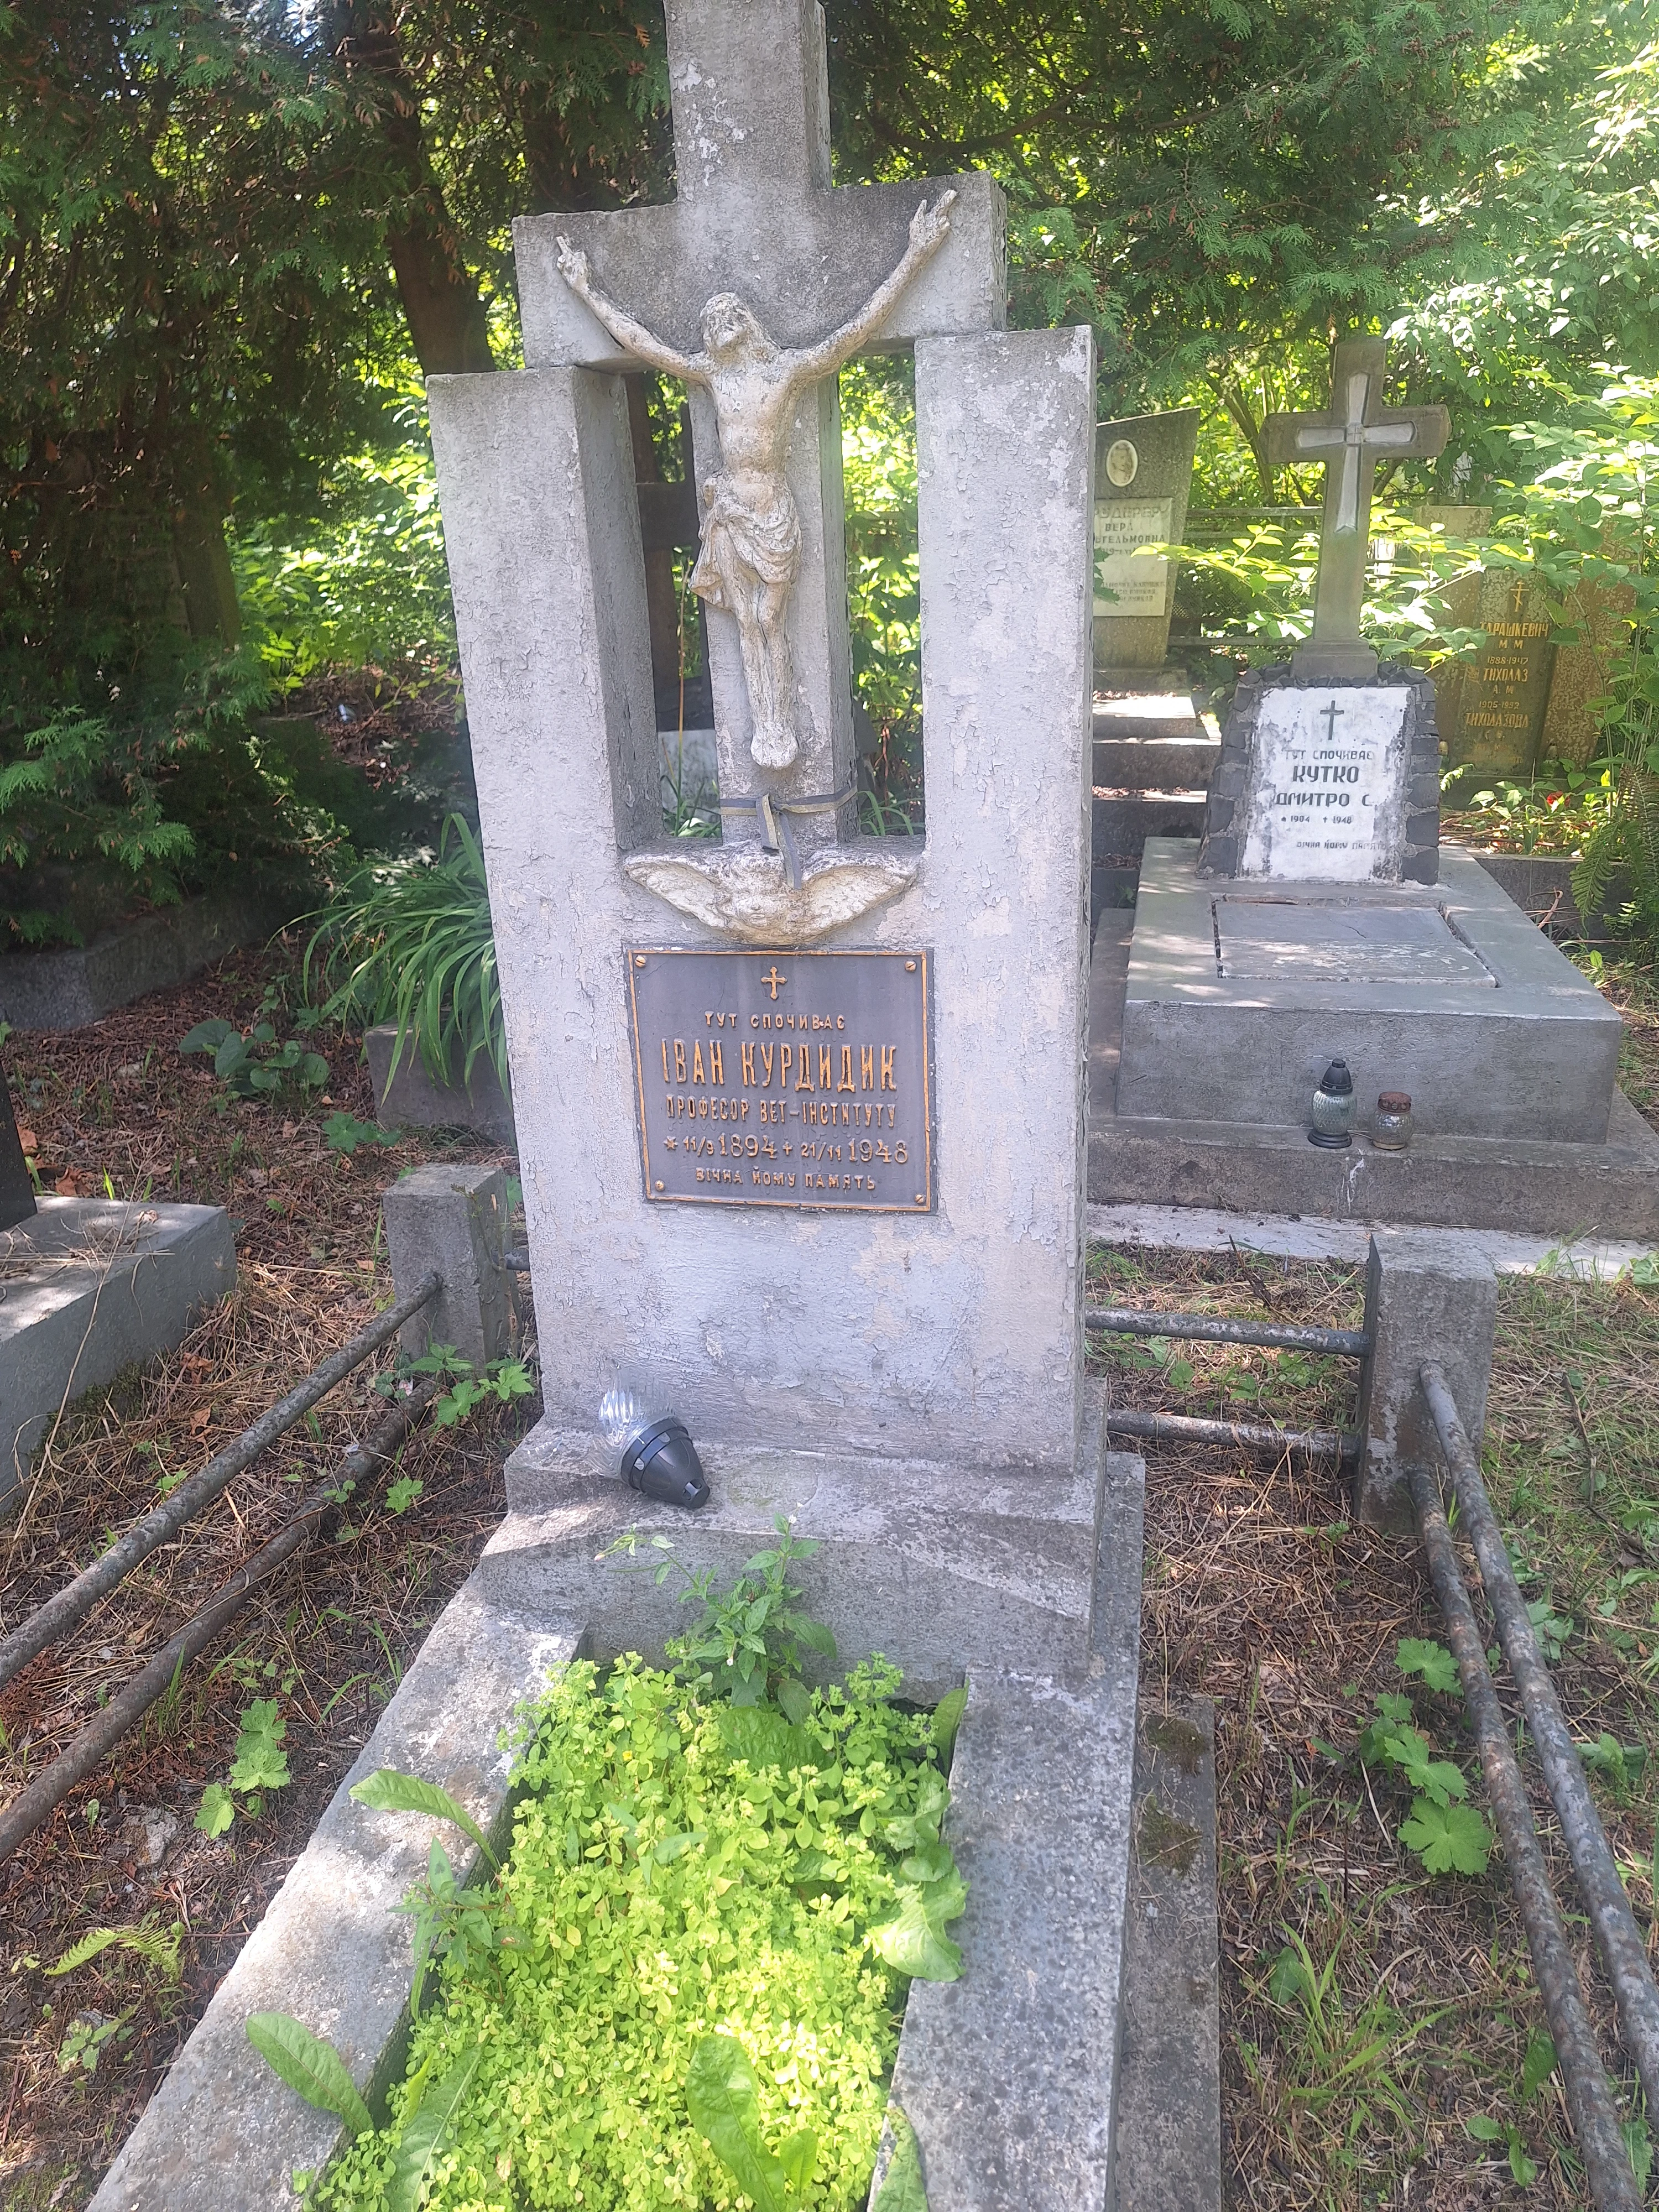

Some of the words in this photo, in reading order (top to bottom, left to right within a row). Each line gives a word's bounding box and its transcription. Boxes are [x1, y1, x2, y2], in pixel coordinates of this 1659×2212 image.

[1483, 667, 1528, 682] ТИХОЛАЗ
[1465, 712, 1529, 728] ТИХОЛАЗОВА
[1284, 750, 1306, 759] ТУТ
[1292, 765, 1359, 783] КУТКО
[1275, 792, 1350, 807] ДМИТРО
[1333, 816, 1353, 824] 1948
[1324, 839, 1348, 849] ЙОМУ
[705, 1010, 738, 1027] ТУТ
[750, 1013, 846, 1030] СПОЧИВАЄ
[661, 1038, 725, 1085] ІВАН
[740, 1041, 897, 1093] КУРДИДИК
[666, 1094, 749, 1121] ПРОФЕСОР
[718, 1132, 778, 1159] 1894
[848, 1138, 909, 1164] 1948
[696, 1167, 743, 1185] ВІЧНА
[752, 1165, 796, 1187] ЙОМУ
[805, 1173, 876, 1190] ПАМЯТЬ
